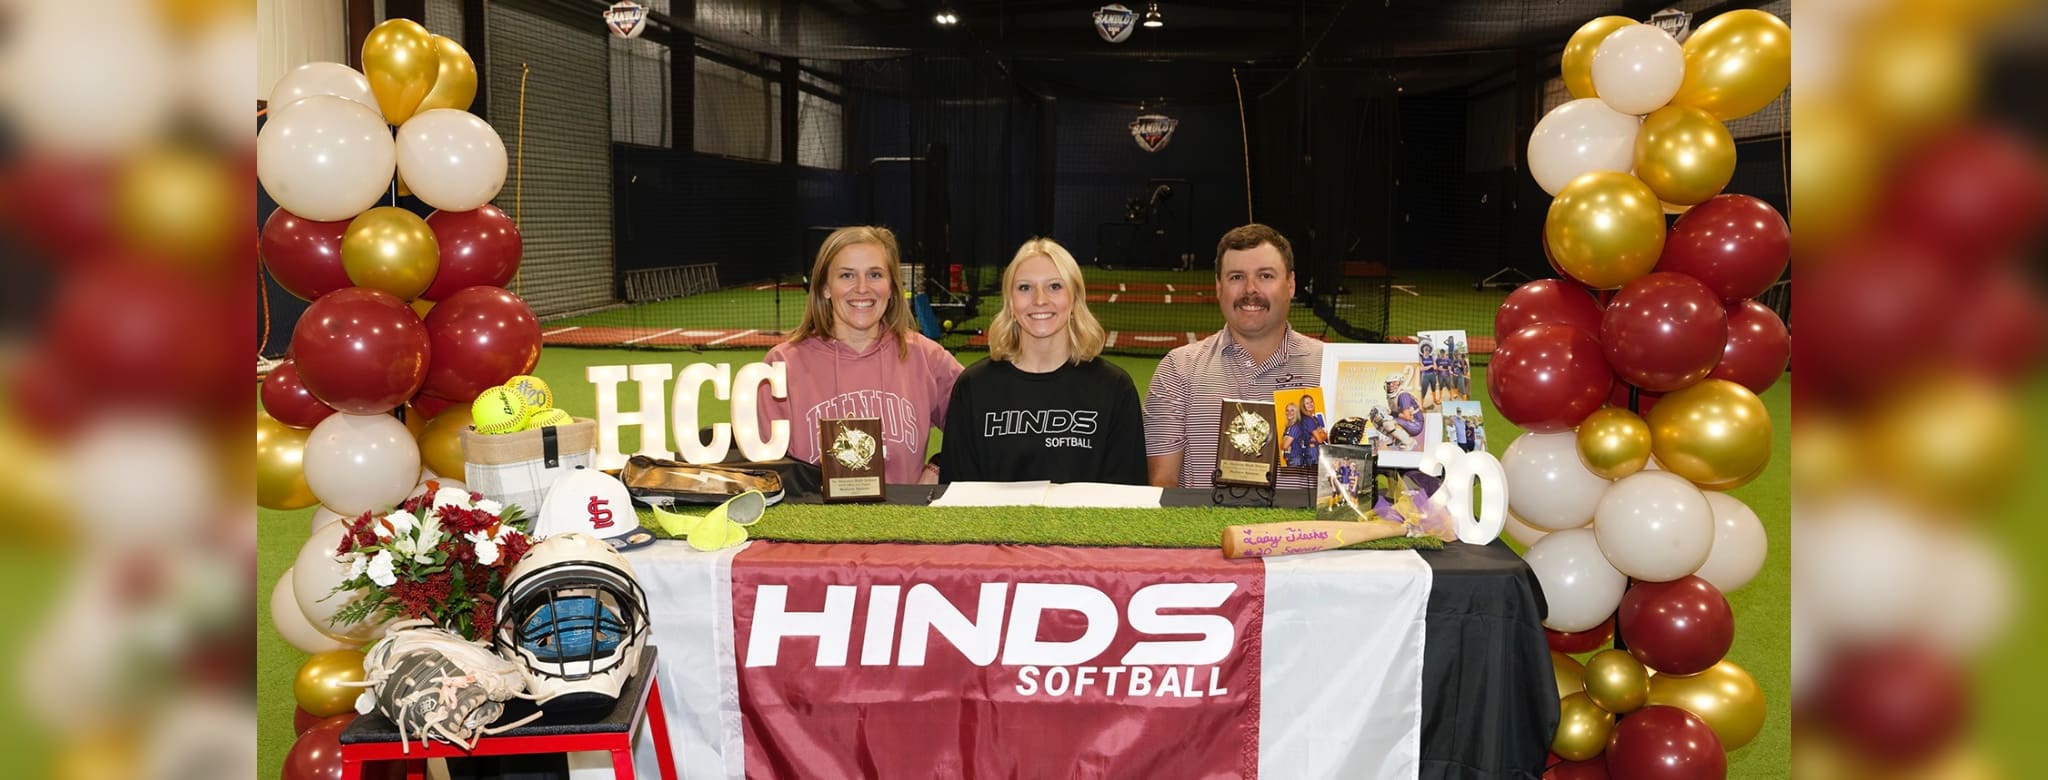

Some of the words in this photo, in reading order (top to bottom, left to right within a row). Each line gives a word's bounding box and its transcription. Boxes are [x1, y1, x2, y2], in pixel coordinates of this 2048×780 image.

[516, 380, 546, 408] #20
[586, 362, 790, 471] HCC
[984, 409, 1098, 437] HINDS
[1045, 437, 1092, 449] SOFTBALL
[745, 582, 1238, 667] HINDS
[1015, 665, 1229, 698] SOFTBALL
